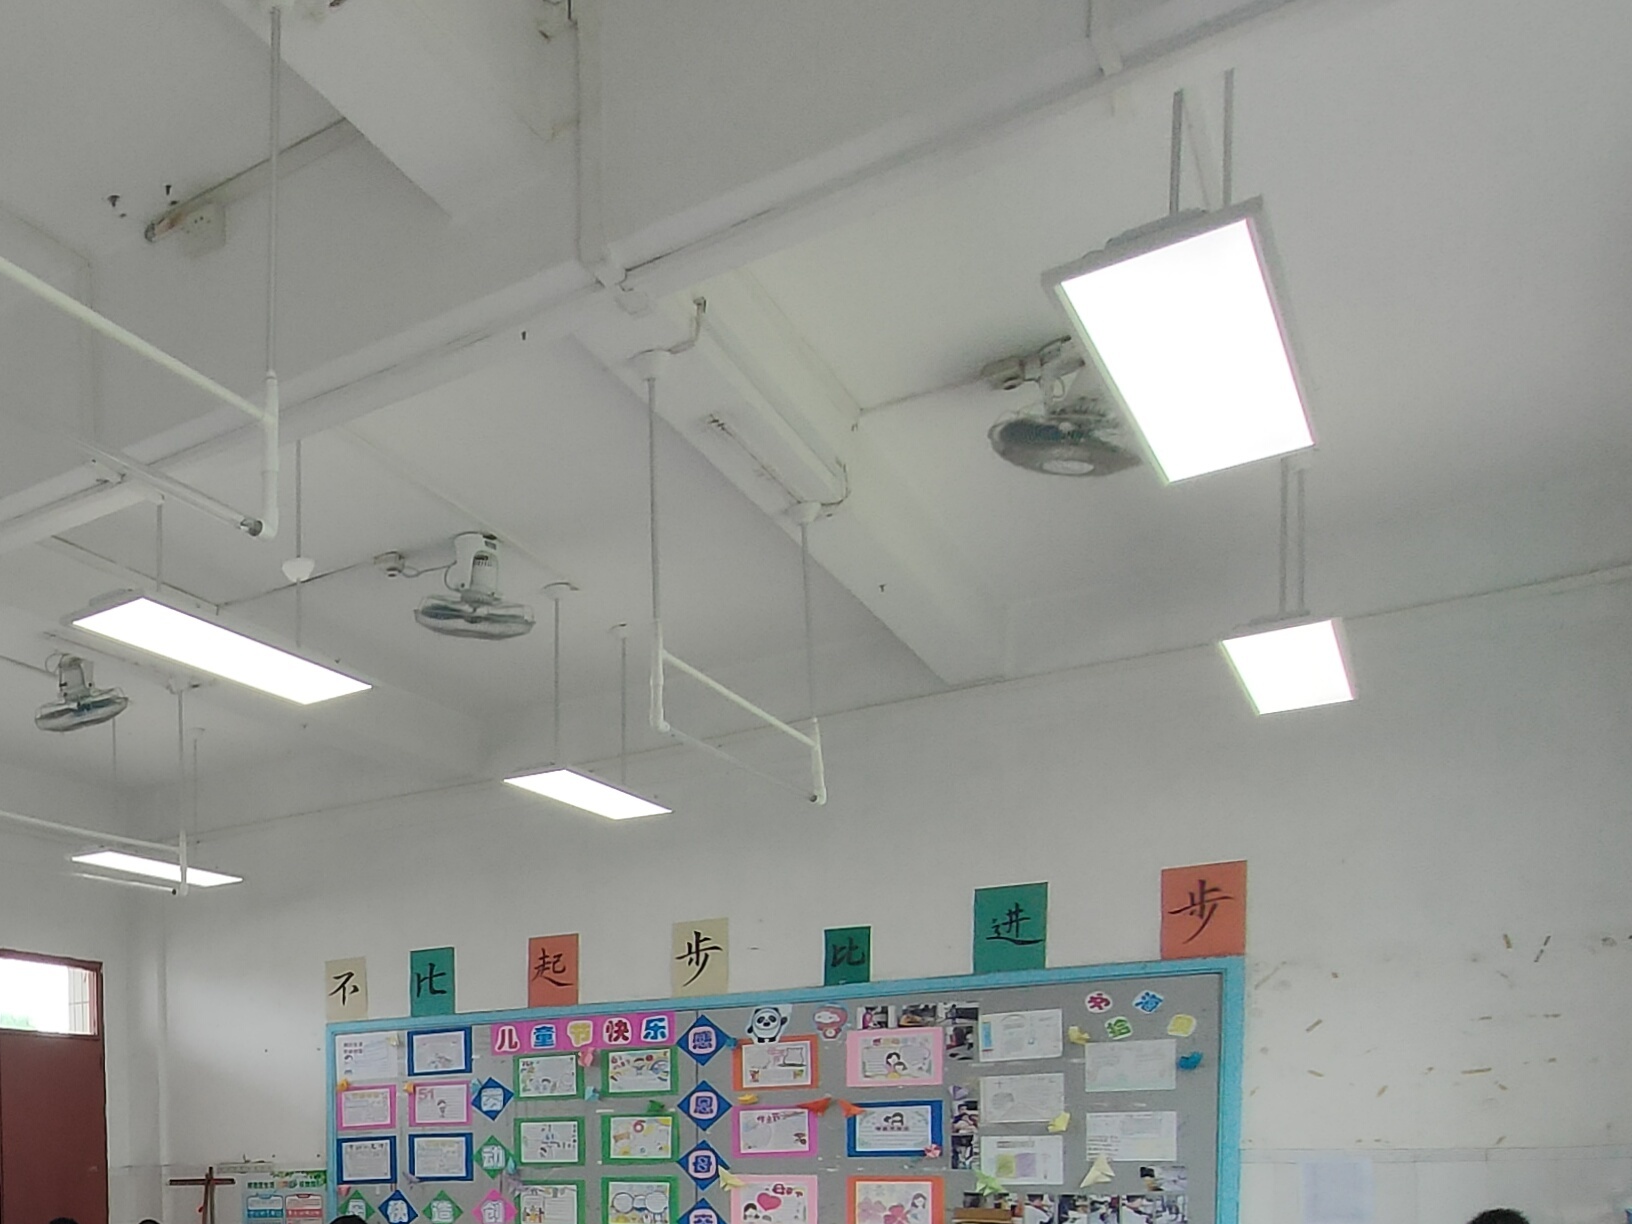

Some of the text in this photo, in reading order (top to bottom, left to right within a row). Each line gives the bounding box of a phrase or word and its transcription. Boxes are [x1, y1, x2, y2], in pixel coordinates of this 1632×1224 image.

[496, 1016, 667, 1050] 儿童节快乐
